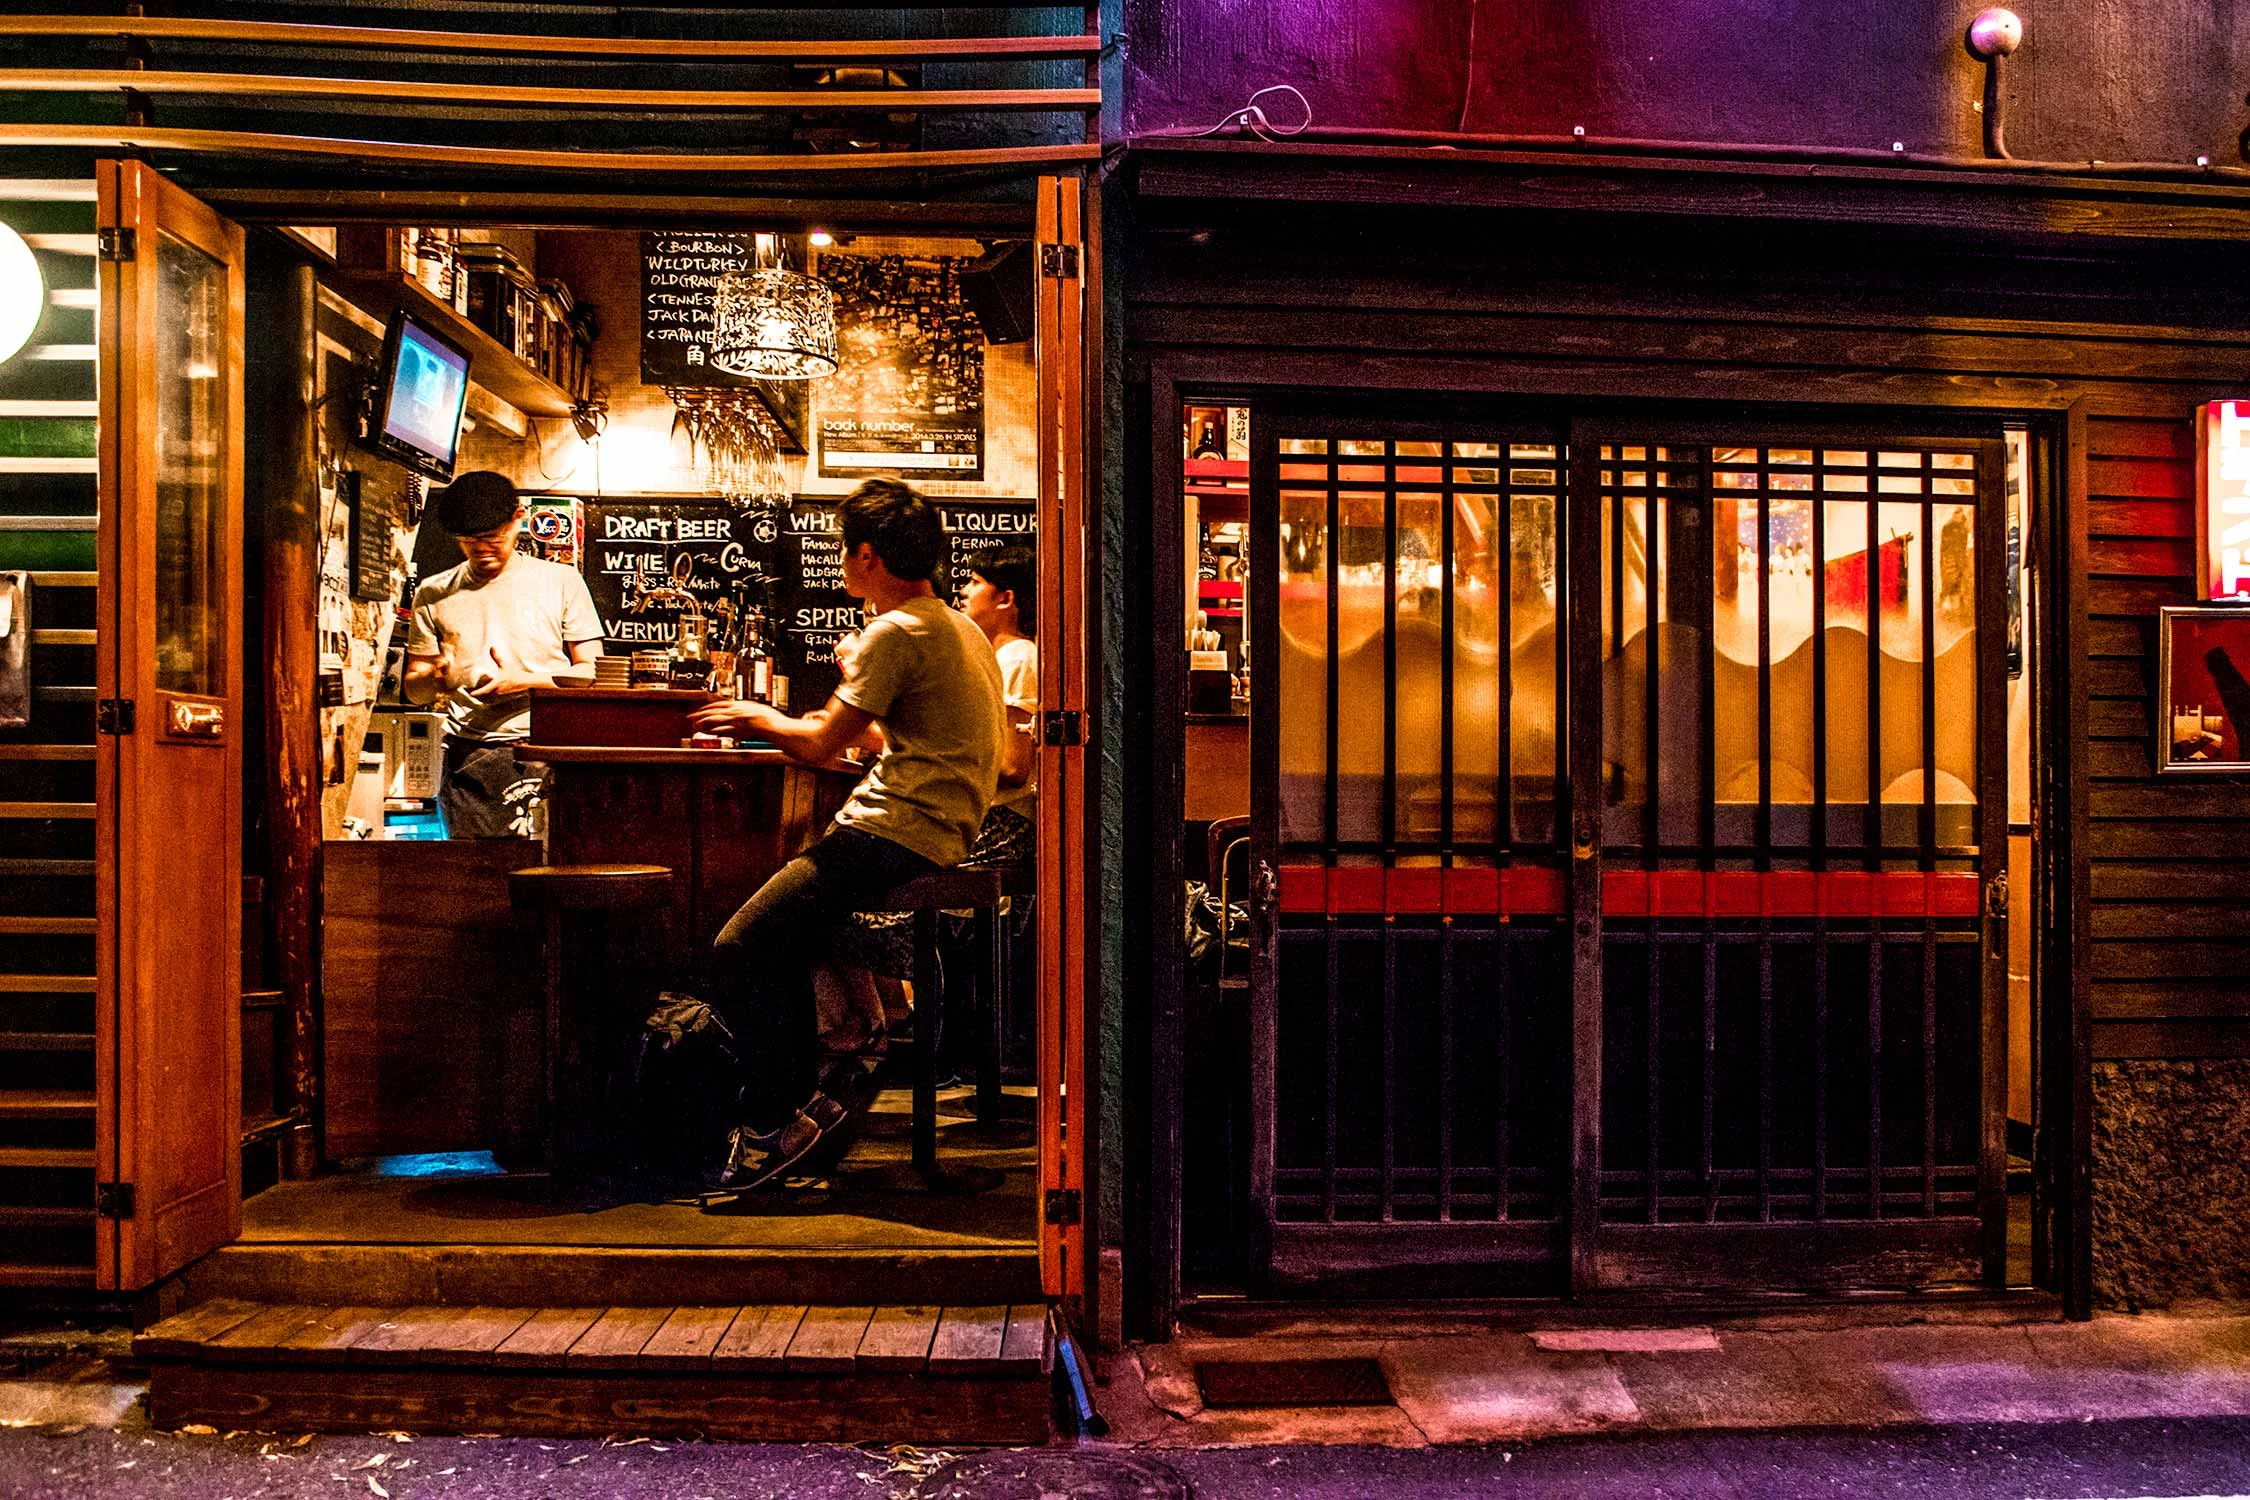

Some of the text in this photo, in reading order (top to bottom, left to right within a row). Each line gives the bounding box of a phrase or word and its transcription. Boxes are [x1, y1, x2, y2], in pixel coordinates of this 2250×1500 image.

[647, 309, 690, 322] JACK
[686, 344, 705, 366] 角
[823, 417, 915, 432] back number
[604, 515, 732, 539] DRAFT BEER
[790, 512, 844, 532] WHI
[803, 578, 829, 589] JACK
